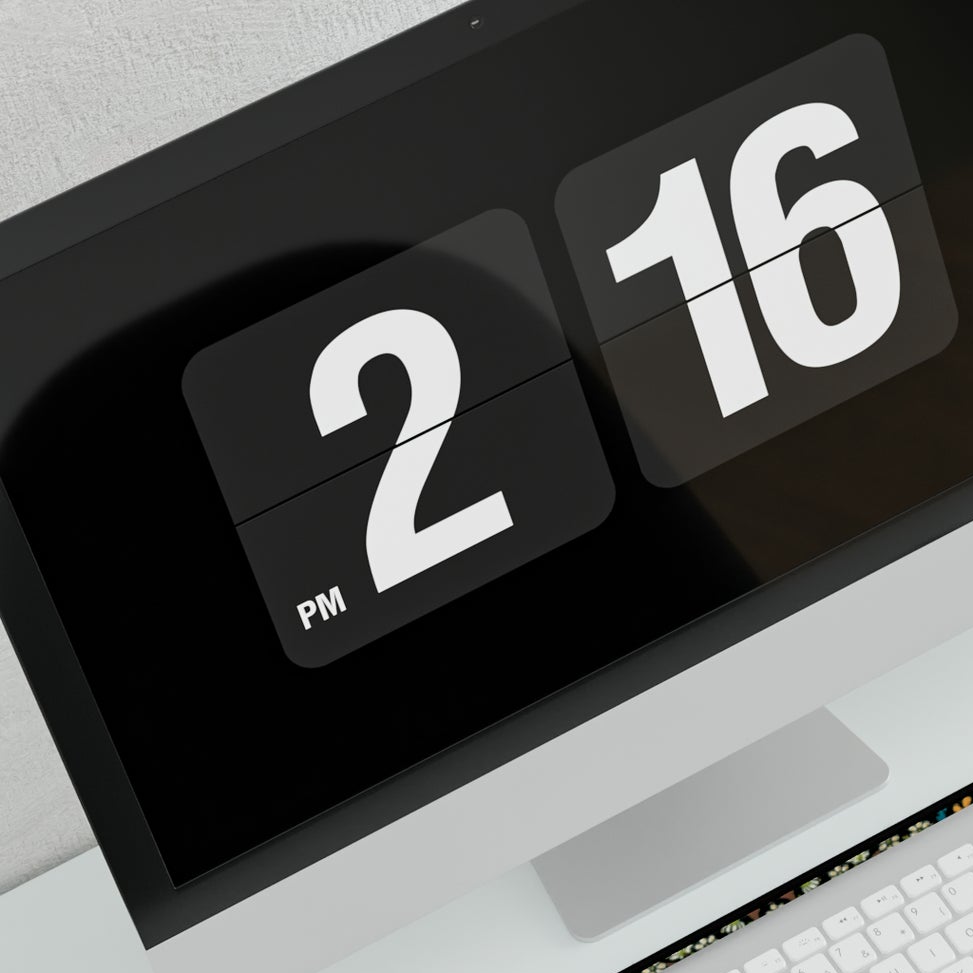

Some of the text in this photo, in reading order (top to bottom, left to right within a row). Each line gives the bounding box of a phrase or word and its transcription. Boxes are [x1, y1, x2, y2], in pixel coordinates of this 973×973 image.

[309, 102, 901, 594] 2 16
[296, 585, 347, 631] PM
[872, 927, 882, 937] 8
